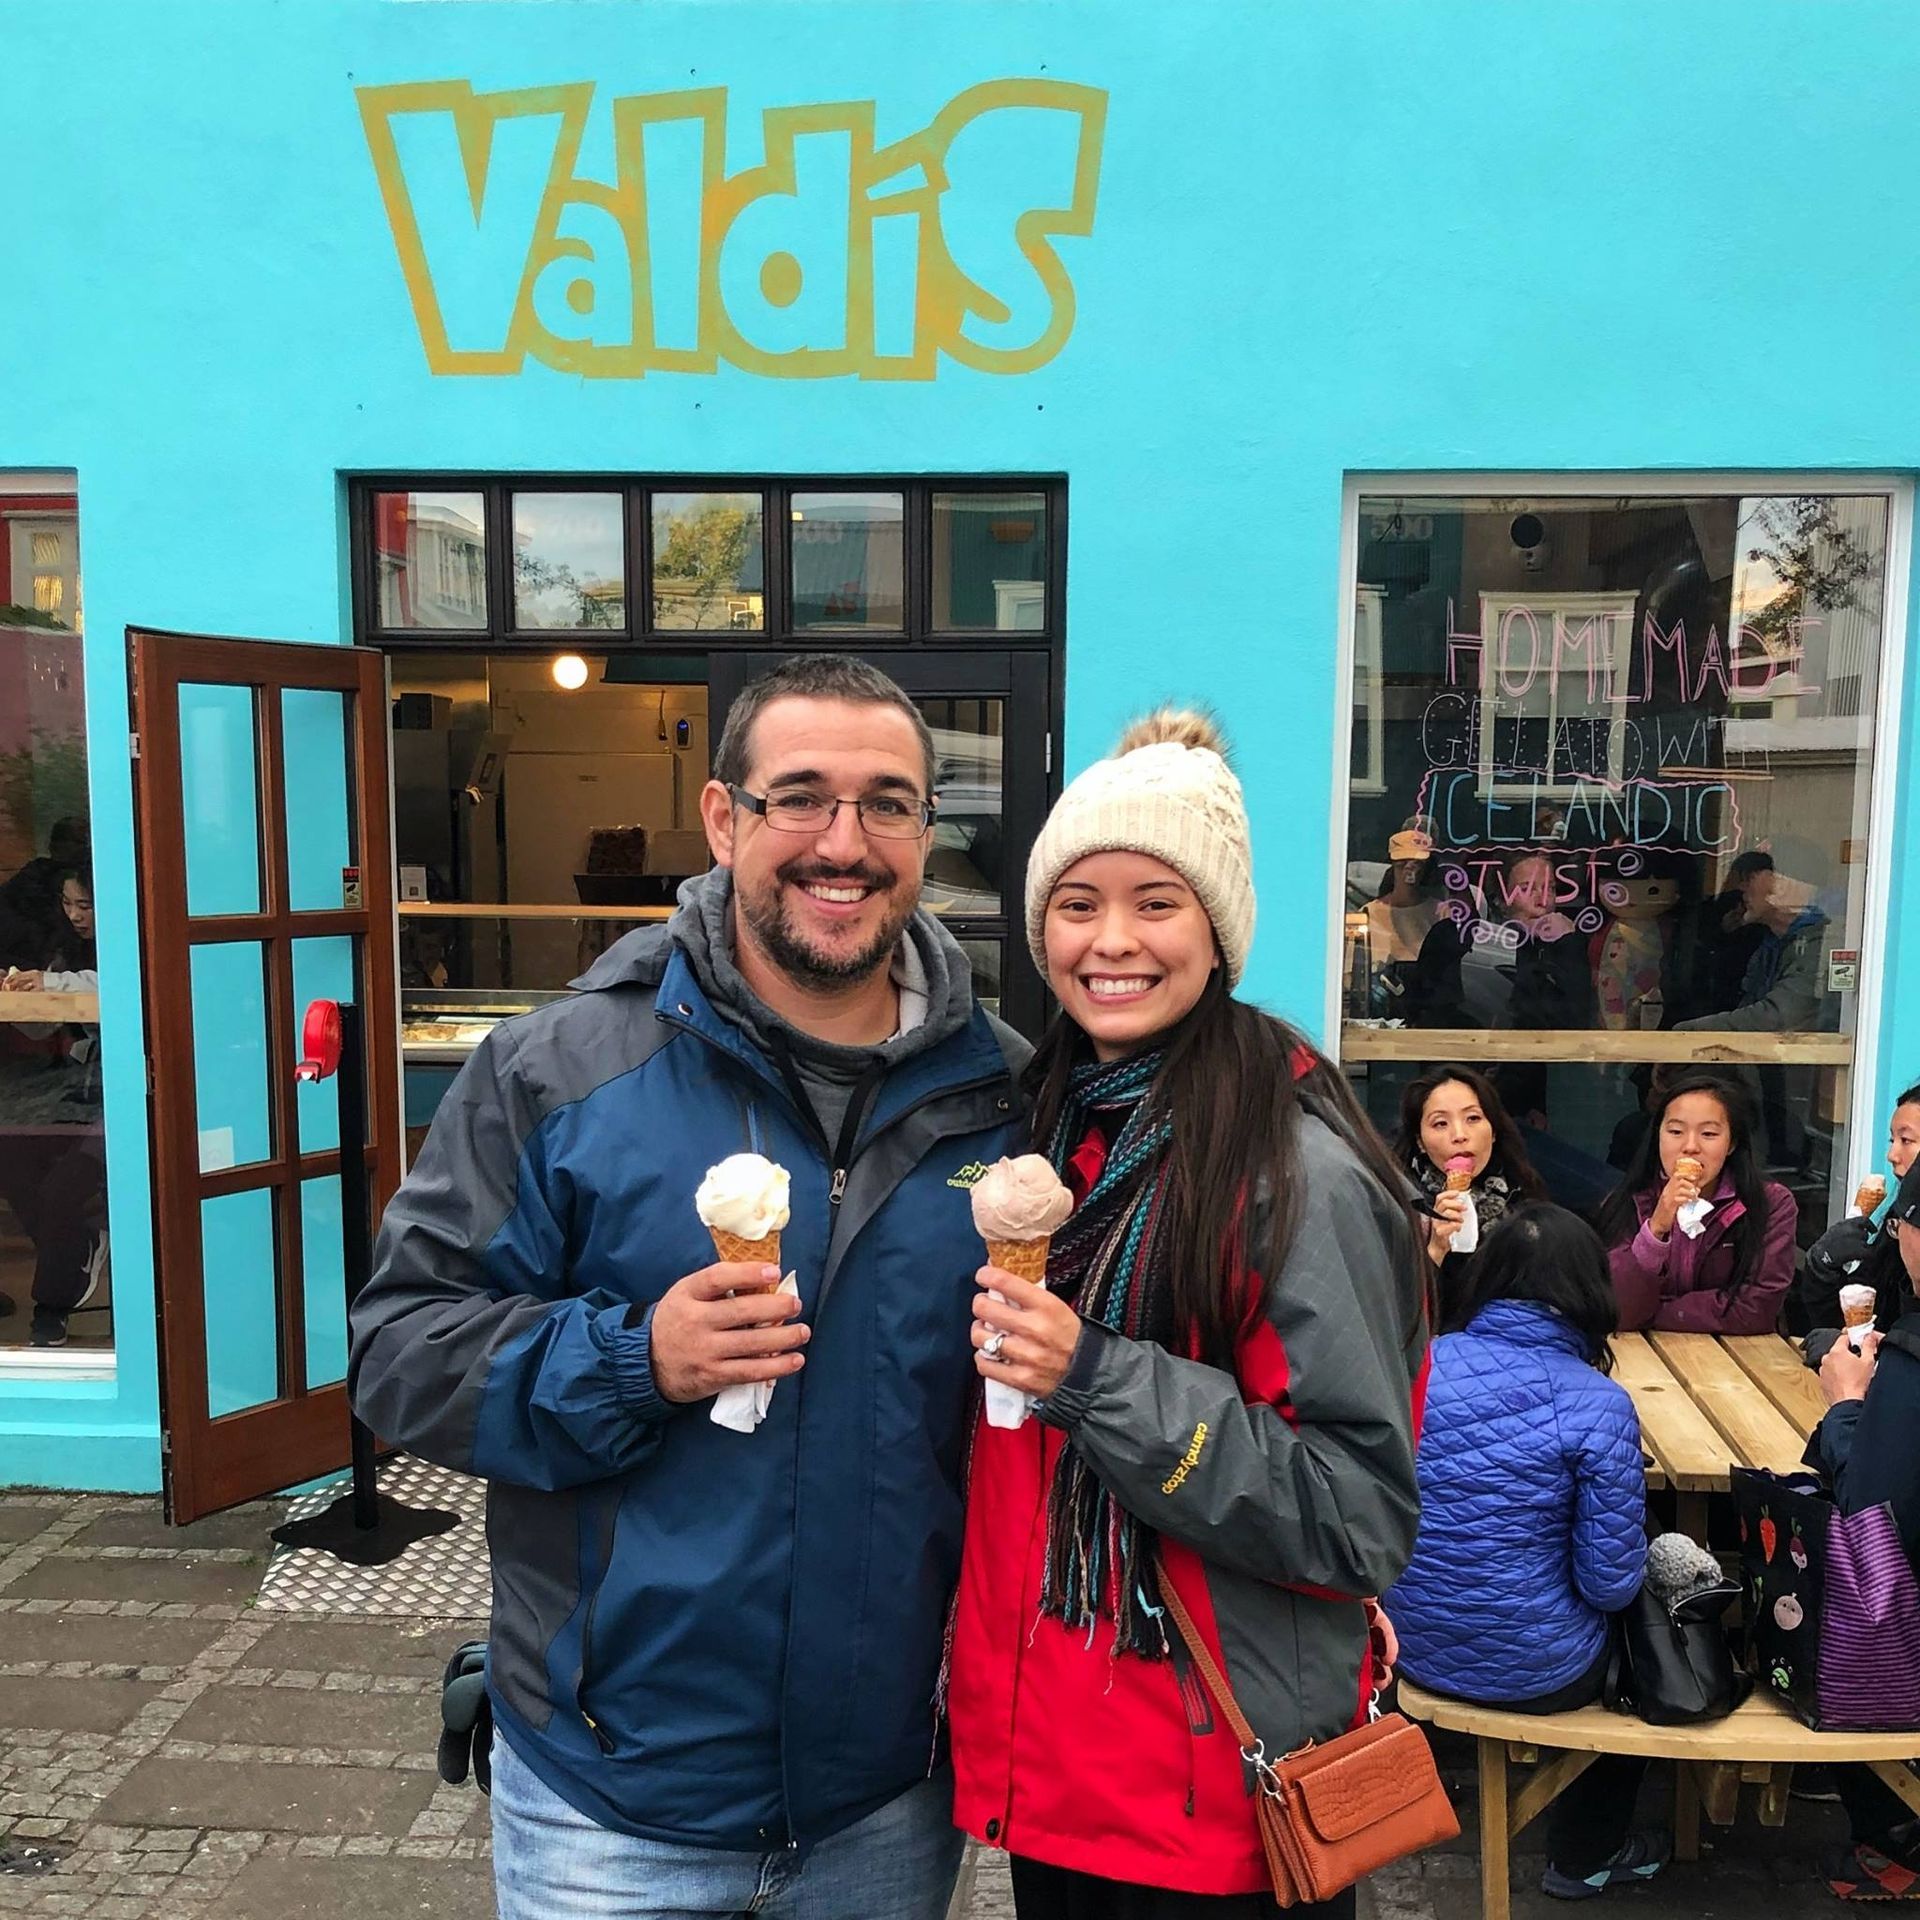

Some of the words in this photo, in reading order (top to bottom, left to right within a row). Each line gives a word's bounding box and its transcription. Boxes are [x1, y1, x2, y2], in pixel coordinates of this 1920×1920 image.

[1446, 598, 1826, 703] HOMEMADE
[1422, 693, 1643, 783] GELATO
[1425, 772, 1729, 846] ICELANDIC
[1467, 860, 1612, 911] TWIST
